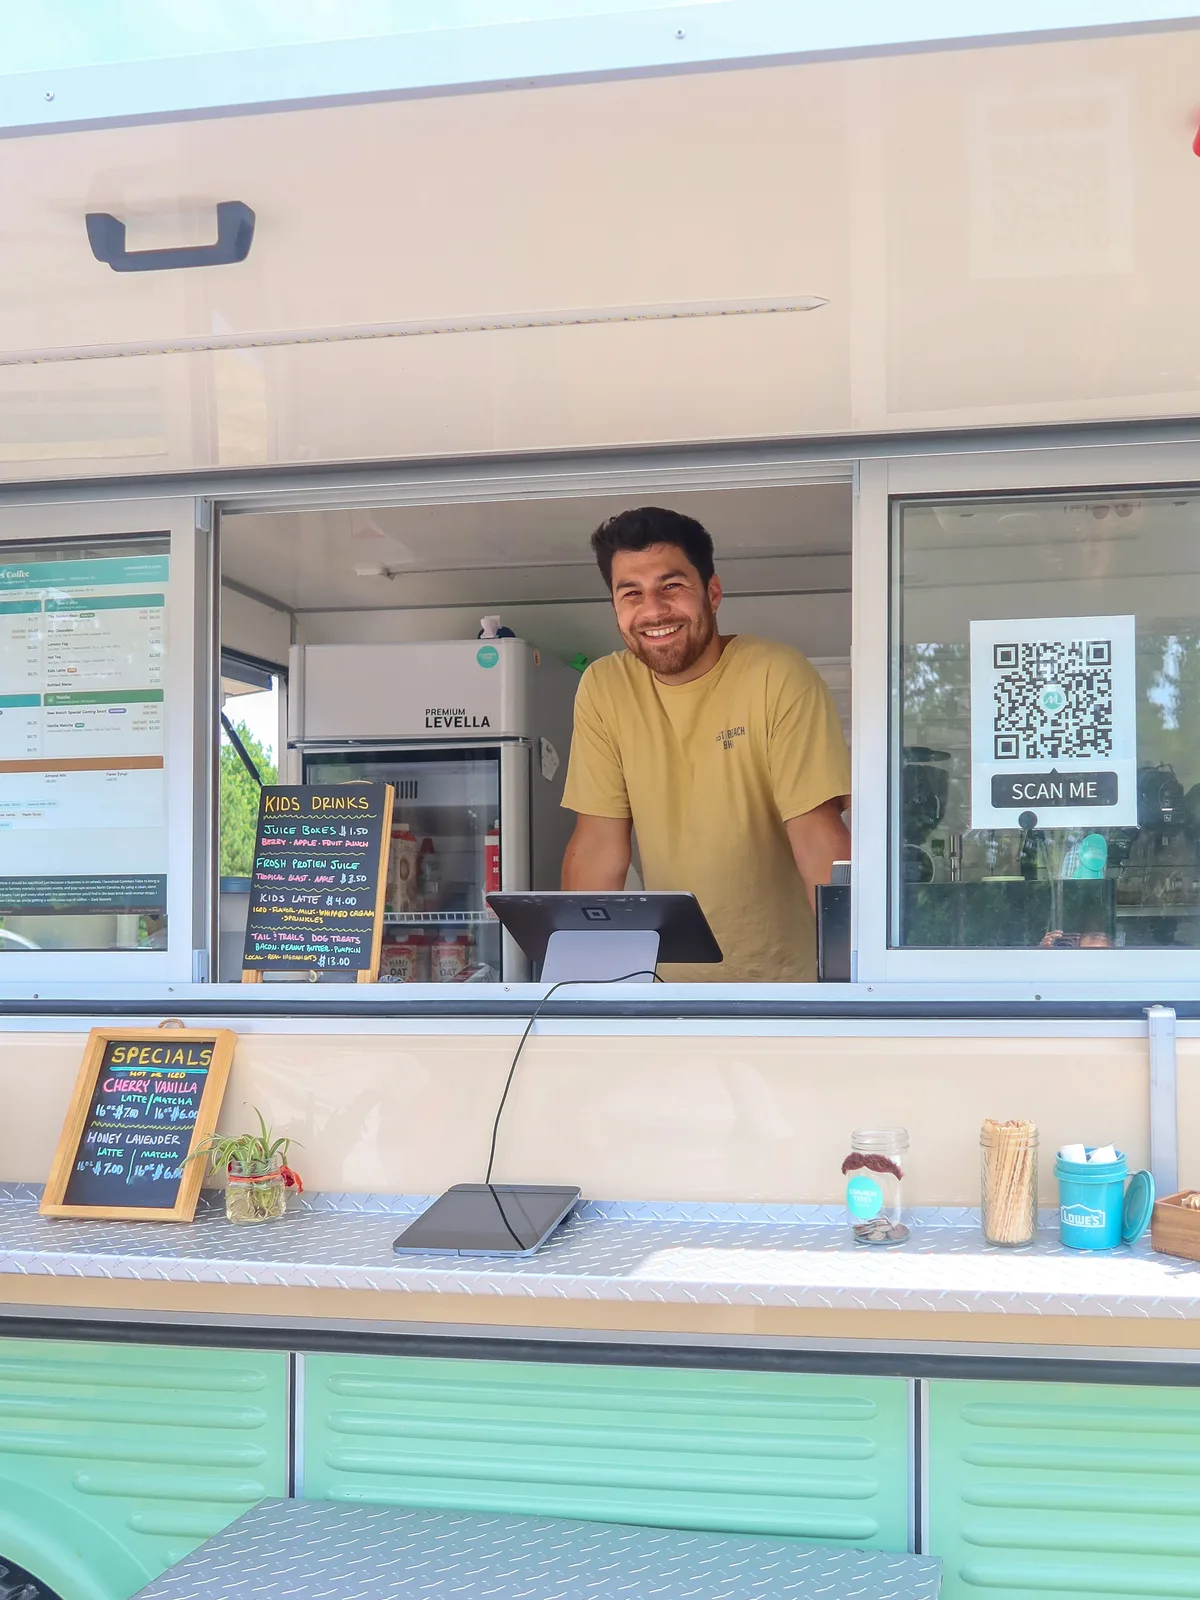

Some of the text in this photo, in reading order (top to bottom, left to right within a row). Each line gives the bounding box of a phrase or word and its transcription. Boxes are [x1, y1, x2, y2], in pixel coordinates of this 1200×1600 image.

[6, 570, 30, 578] Coffee
[425, 708, 466, 716] PREMIUM
[425, 716, 490, 728] LEVELLA
[727, 726, 745, 739] BEACH
[1012, 781, 1097, 800] SCAN ME
[265, 795, 369, 812] KIDS DRINKS
[263, 825, 296, 835] JUICE
[302, 825, 336, 835] BOXES
[261, 838, 286, 846] BERRY
[256, 858, 360, 870] FROSH PROTIEN JUICE
[255, 873, 285, 881] TROPICAL
[259, 893, 357, 905] KIDS LATTE $4.00
[251, 932, 271, 940] TAIL
[311, 933, 329, 942] DOG
[330, 935, 361, 944] TREATS
[255, 943, 277, 951] BACON
[334, 946, 361, 954] PUMPKIN
[318, 955, 350, 967] $13.00
[390, 968, 408, 976] OAT
[440, 968, 457, 976] OAT
[111, 1046, 212, 1066] SPECIALS
[103, 1078, 198, 1094] CHERRY VANILLA
[121, 1094, 192, 1105] LATTE MATCHA
[87, 1131, 180, 1145] HONEY LAVENDER
[97, 1147, 124, 1157] LATTE
[1064, 1210, 1100, 1225] LOWE'S
